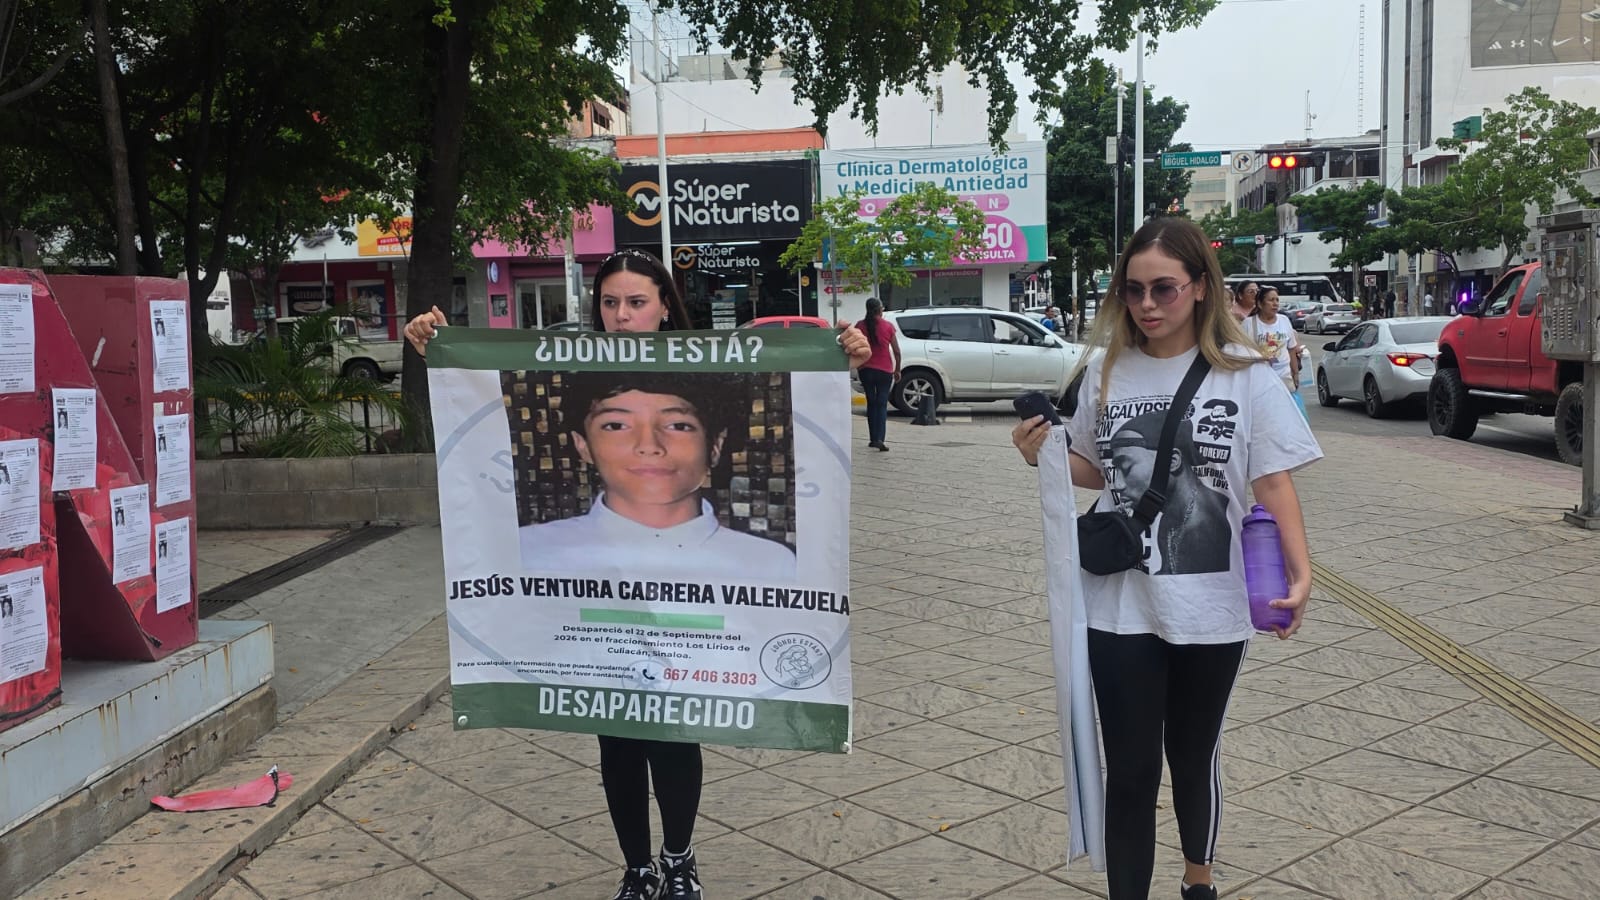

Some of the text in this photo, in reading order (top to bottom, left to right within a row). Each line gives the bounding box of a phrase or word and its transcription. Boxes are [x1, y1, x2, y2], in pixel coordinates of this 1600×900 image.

[837, 155, 1028, 177] Clínica Dermatológica
[1164, 155, 1219, 166] MIGUEL HIDALGO
[944, 173, 1028, 192] Antiedad
[673, 178, 750, 207] Súper
[674, 200, 800, 226] Naturista
[697, 245, 735, 257] Súper
[698, 255, 760, 268] Naturista
[535, 332, 764, 363] ¿DÓNDE ESTÁ?
[1096, 419, 1113, 438] OW
[1196, 424, 1234, 440] PAC
[1199, 445, 1229, 460] FOREVER
[1212, 477, 1229, 490] LOVE
[450, 574, 850, 616] JESÚS VENTURA CABRERA VALENZUELA
[562, 625, 623, 634] Desapareció
[625, 627, 634, 635] el
[636, 628, 645, 636] 22
[662, 631, 722, 640] Septiembre
[594, 635, 603, 643] el
[706, 643, 735, 651] Lirios
[607, 647, 692, 659] Culiacán, Sinaloa.
[513, 660, 556, 668] información
[663, 668, 757, 685] 667 406 3303
[539, 686, 756, 730] DESAPARECIDO
